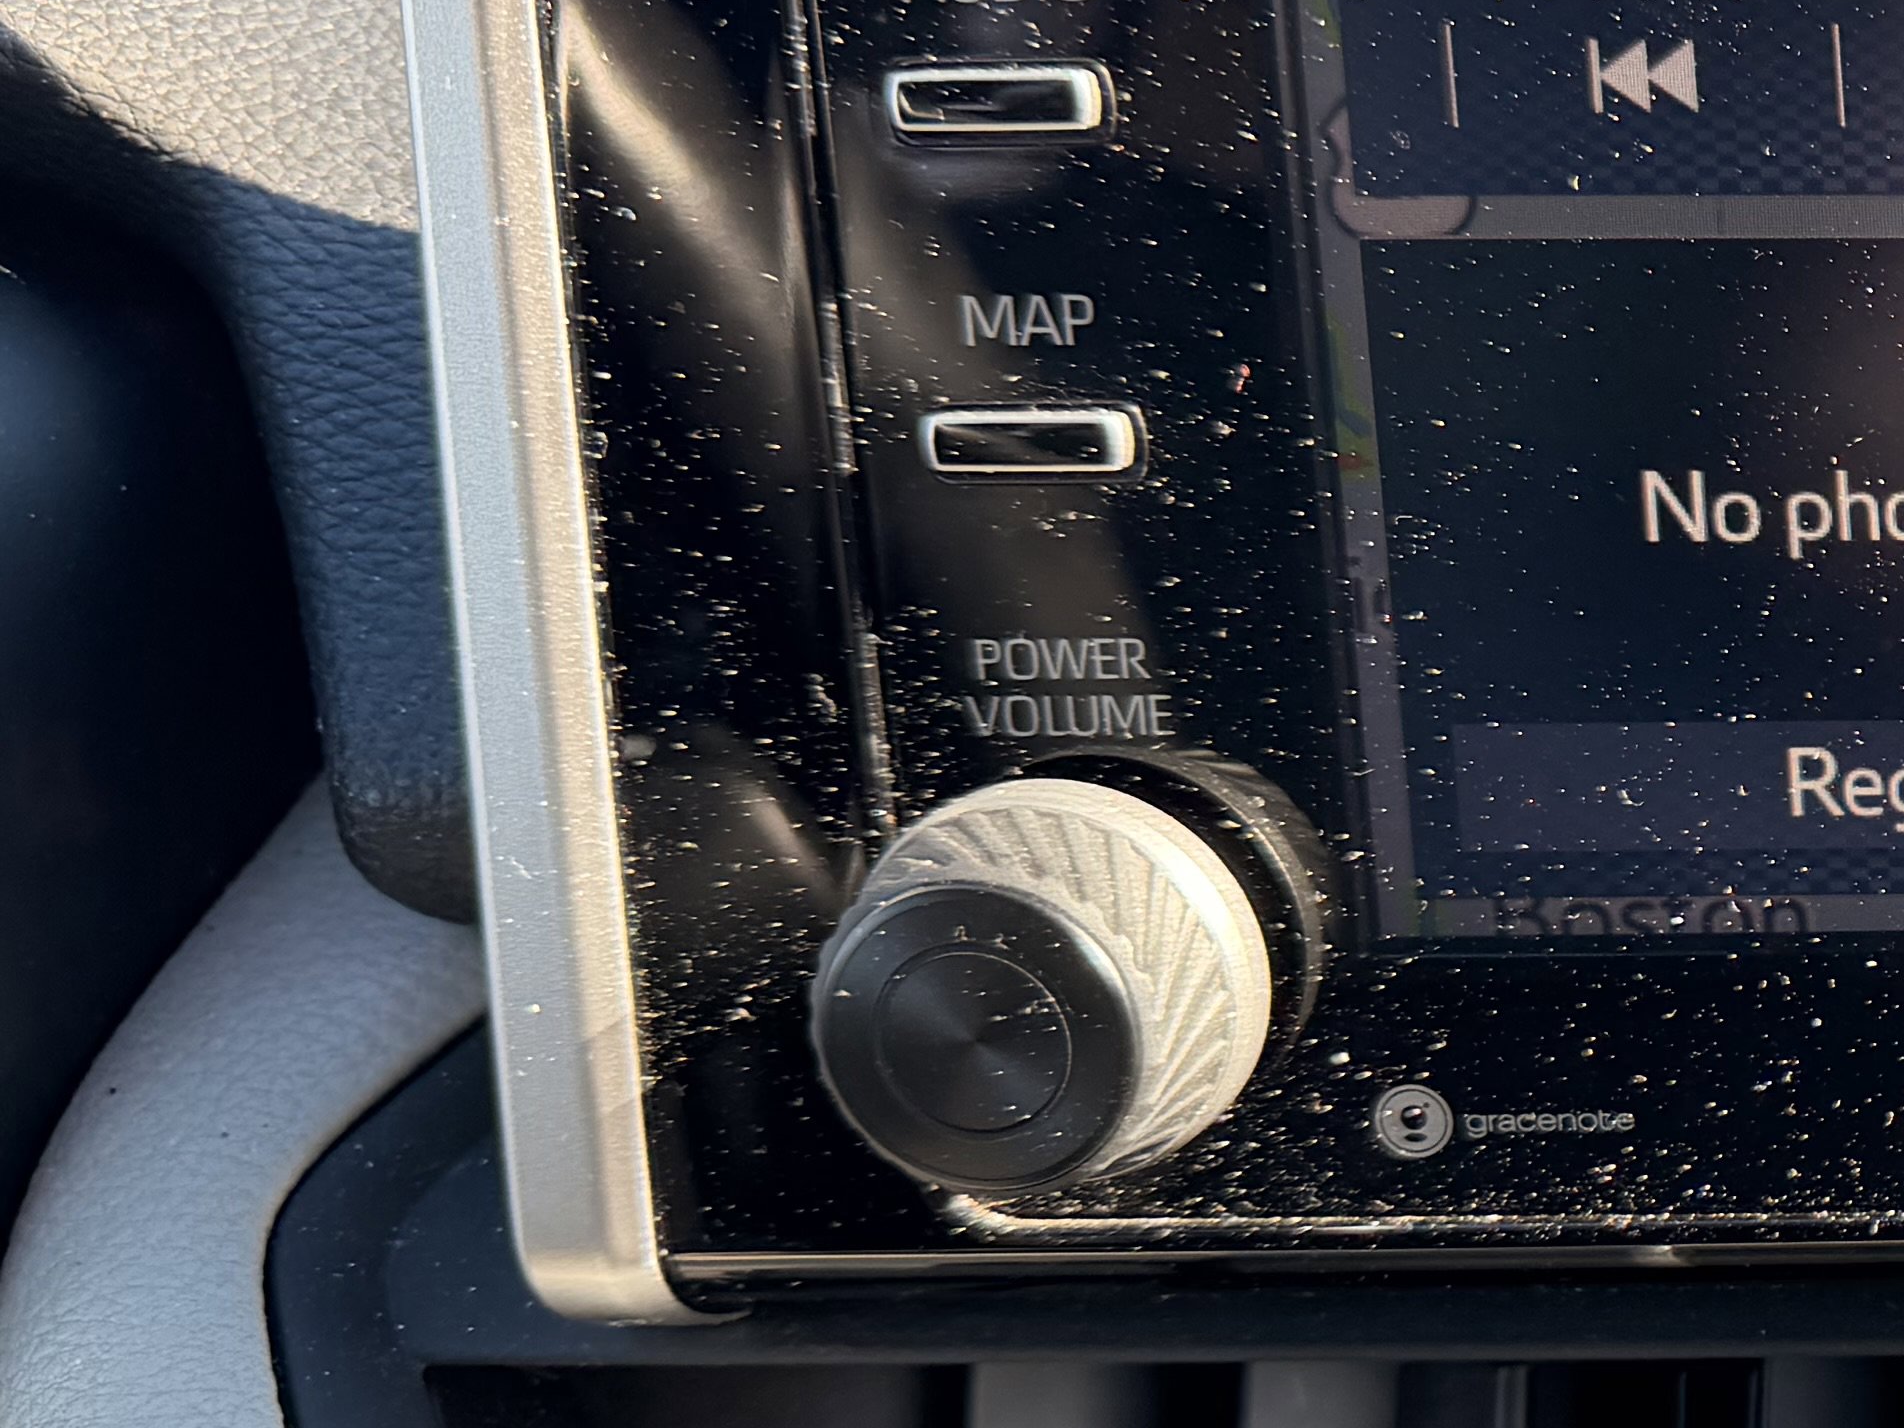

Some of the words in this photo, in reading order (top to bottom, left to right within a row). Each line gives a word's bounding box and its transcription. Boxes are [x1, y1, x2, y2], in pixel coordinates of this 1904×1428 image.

[960, 292, 1096, 348] MAP
[1640, 468, 1763, 544] No
[973, 637, 1152, 681] POWER
[962, 694, 1177, 738] VOLUME
[1466, 1108, 1636, 1140] gracenote
